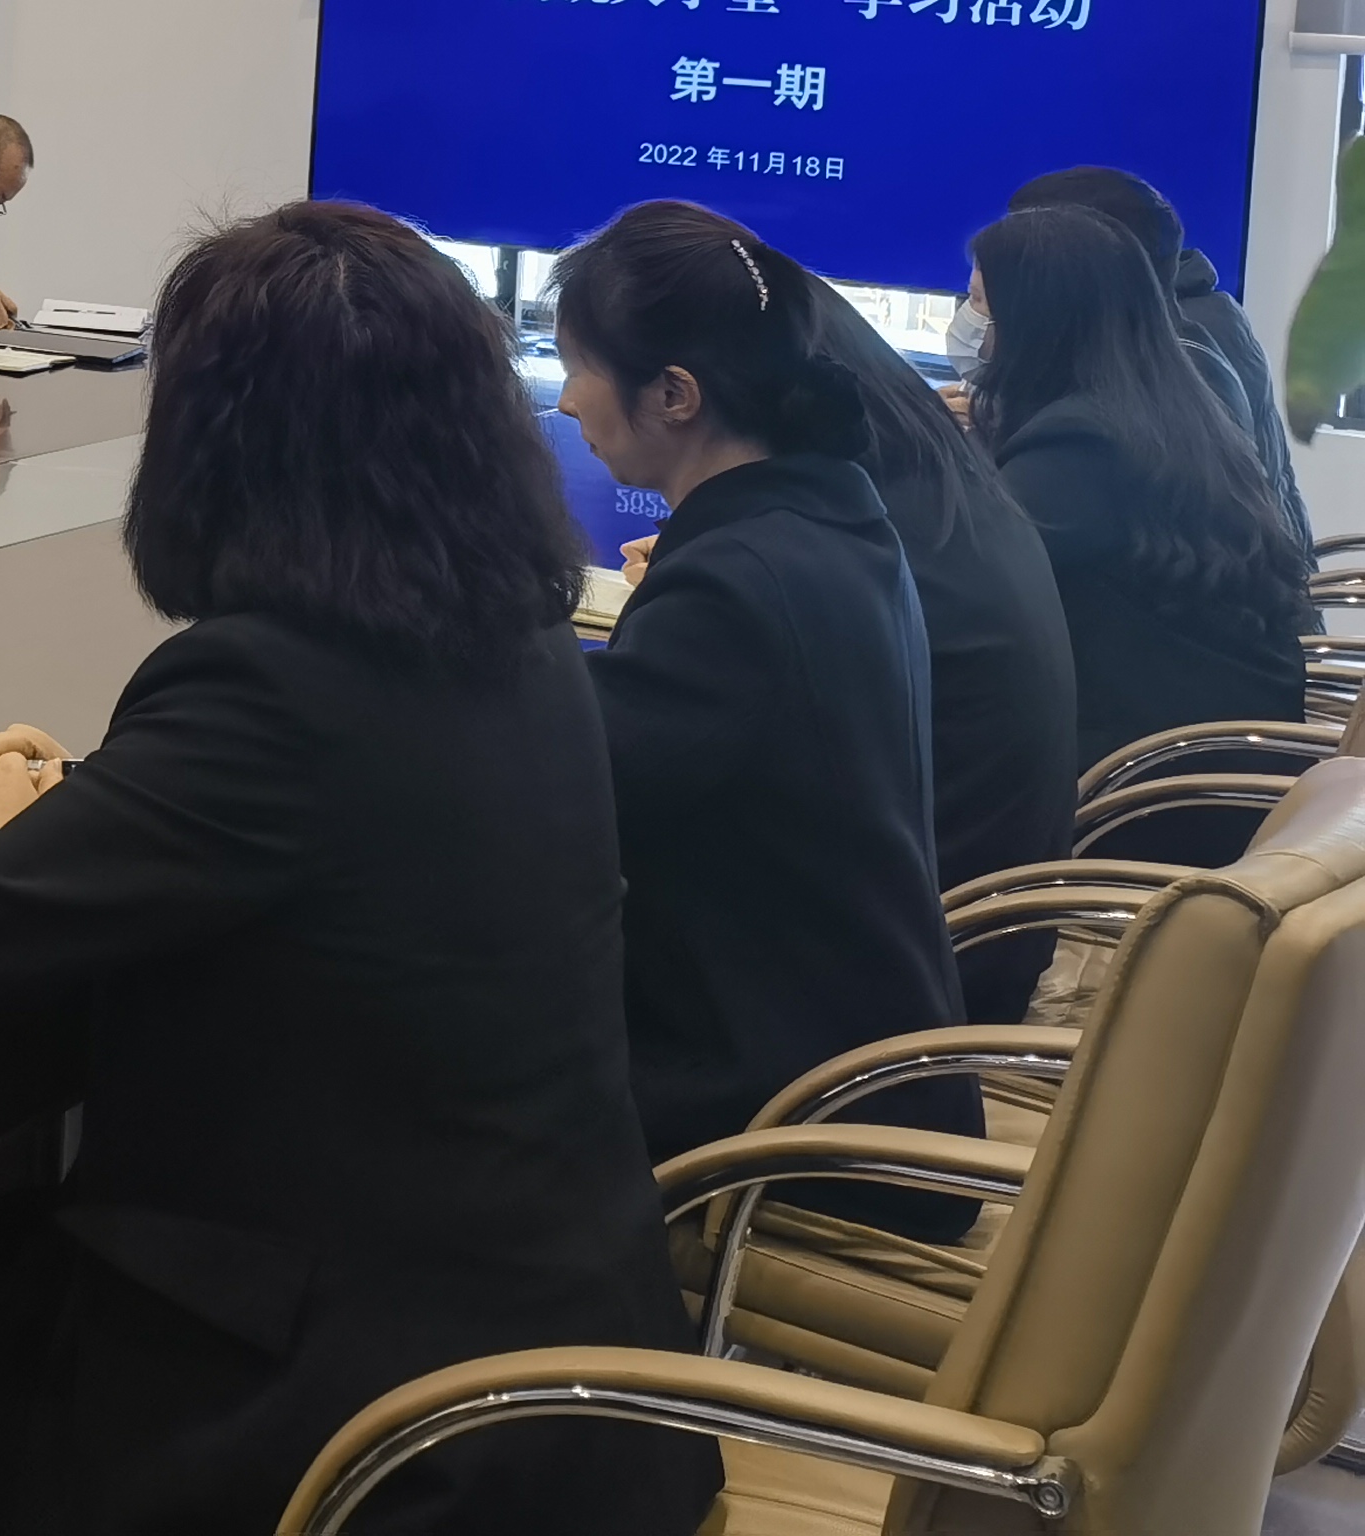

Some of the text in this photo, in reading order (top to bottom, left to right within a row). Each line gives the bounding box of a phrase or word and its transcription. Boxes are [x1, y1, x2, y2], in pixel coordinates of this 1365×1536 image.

[670, 56, 825, 110] 第一期
[639, 143, 697, 166] 2022
